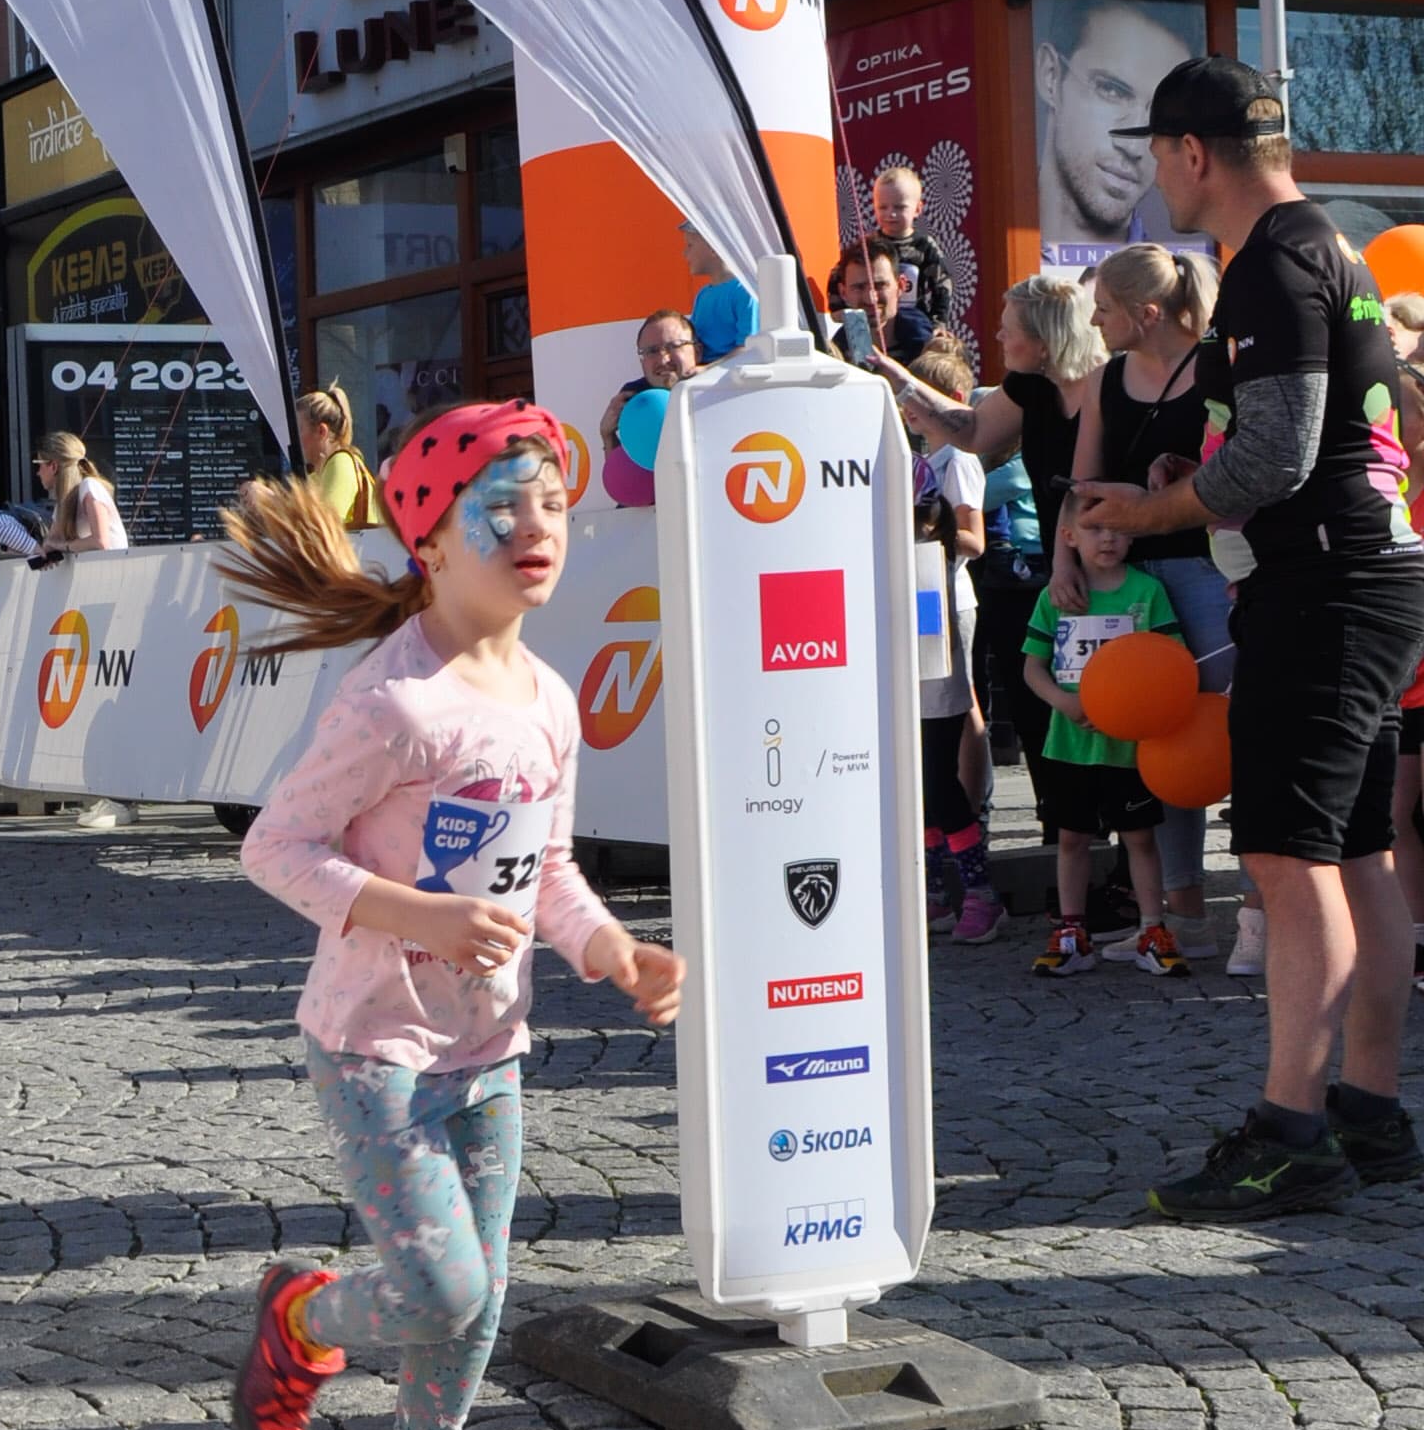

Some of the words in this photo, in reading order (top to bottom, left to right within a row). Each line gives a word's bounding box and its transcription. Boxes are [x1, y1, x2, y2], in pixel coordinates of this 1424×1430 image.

[856, 44, 922, 71] OPTIKA
[838, 67, 971, 123] UNETTES
[51, 361, 118, 392] 04
[820, 459, 871, 488] NN
[770, 640, 837, 663] AVON
[95, 649, 135, 687] NN
[832, 750, 870, 762] Powered
[833, 763, 844, 774] by
[847, 762, 870, 772] MVM
[745, 796, 803, 815] innogy
[436, 816, 477, 833] KIDS
[434, 835, 470, 849] CUP
[788, 864, 836, 874] PEUGEOT
[773, 979, 859, 1003] NUTREND
[801, 1127, 872, 1154] ŠKODA
[784, 1216, 863, 1246] KPMG
